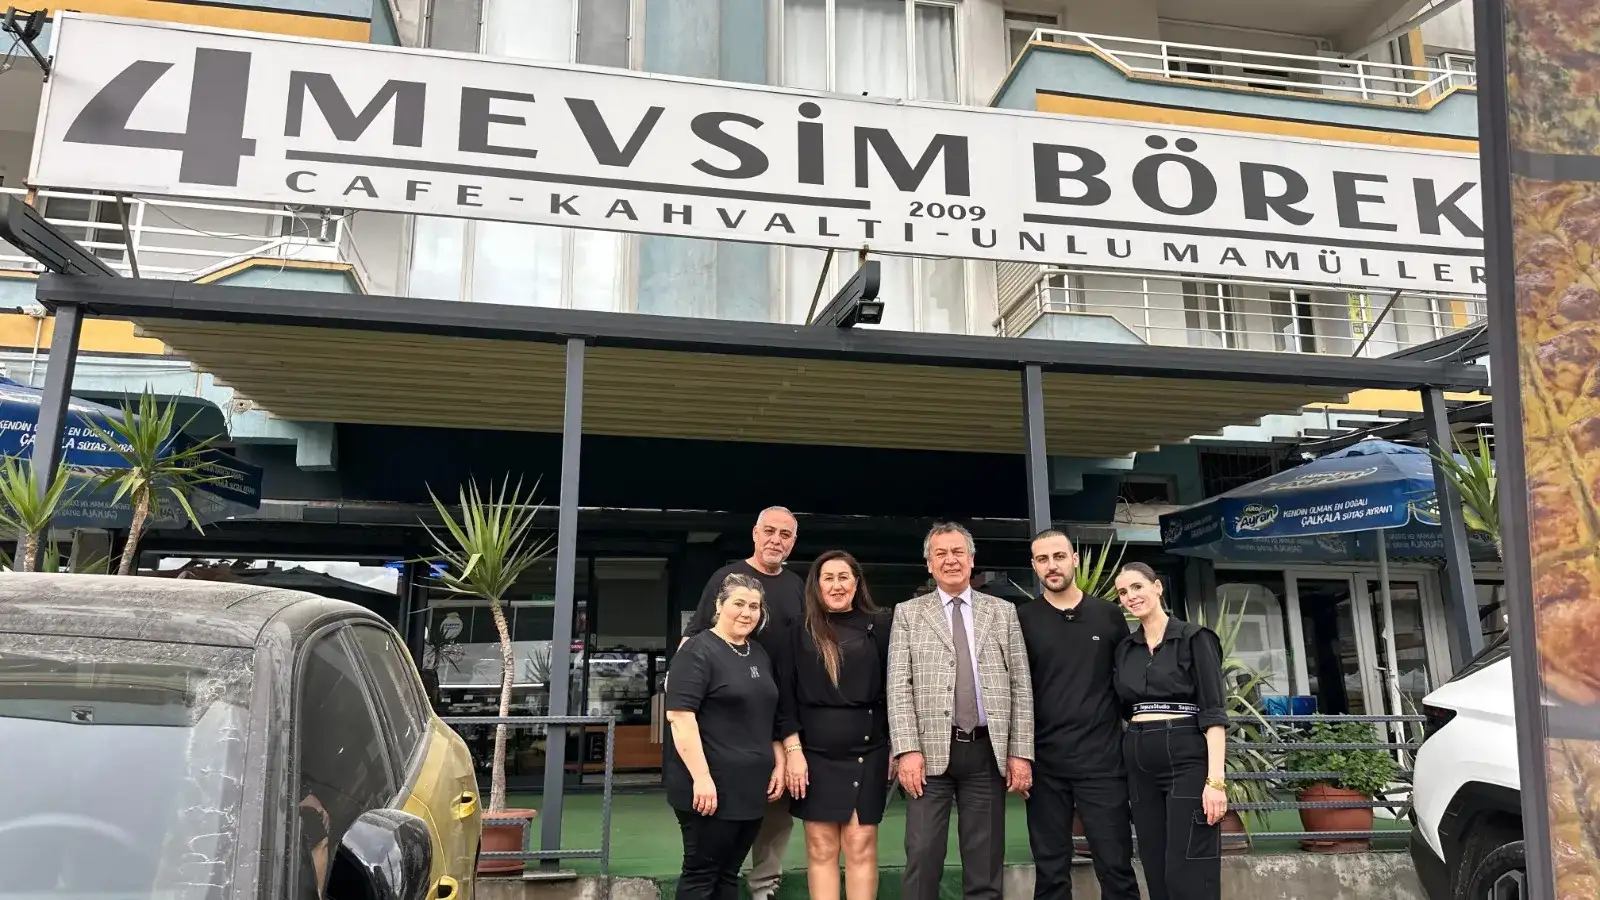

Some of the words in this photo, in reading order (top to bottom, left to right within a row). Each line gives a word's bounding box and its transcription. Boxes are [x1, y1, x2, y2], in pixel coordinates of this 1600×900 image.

[63, 47, 256, 187] 4
[284, 71, 970, 197] MEVSİM
[1033, 135, 1484, 238] BÖREK
[910, 202, 986, 222] 2009
[1163, 242, 1486, 284] MAMÜLLER
[68, 427, 81, 437] EN
[1309, 504, 1333, 514] OLMAK
[1334, 502, 1343, 511] EN
[1240, 510, 1273, 528] Ayran
[1301, 512, 1340, 527] ÇALKALA
